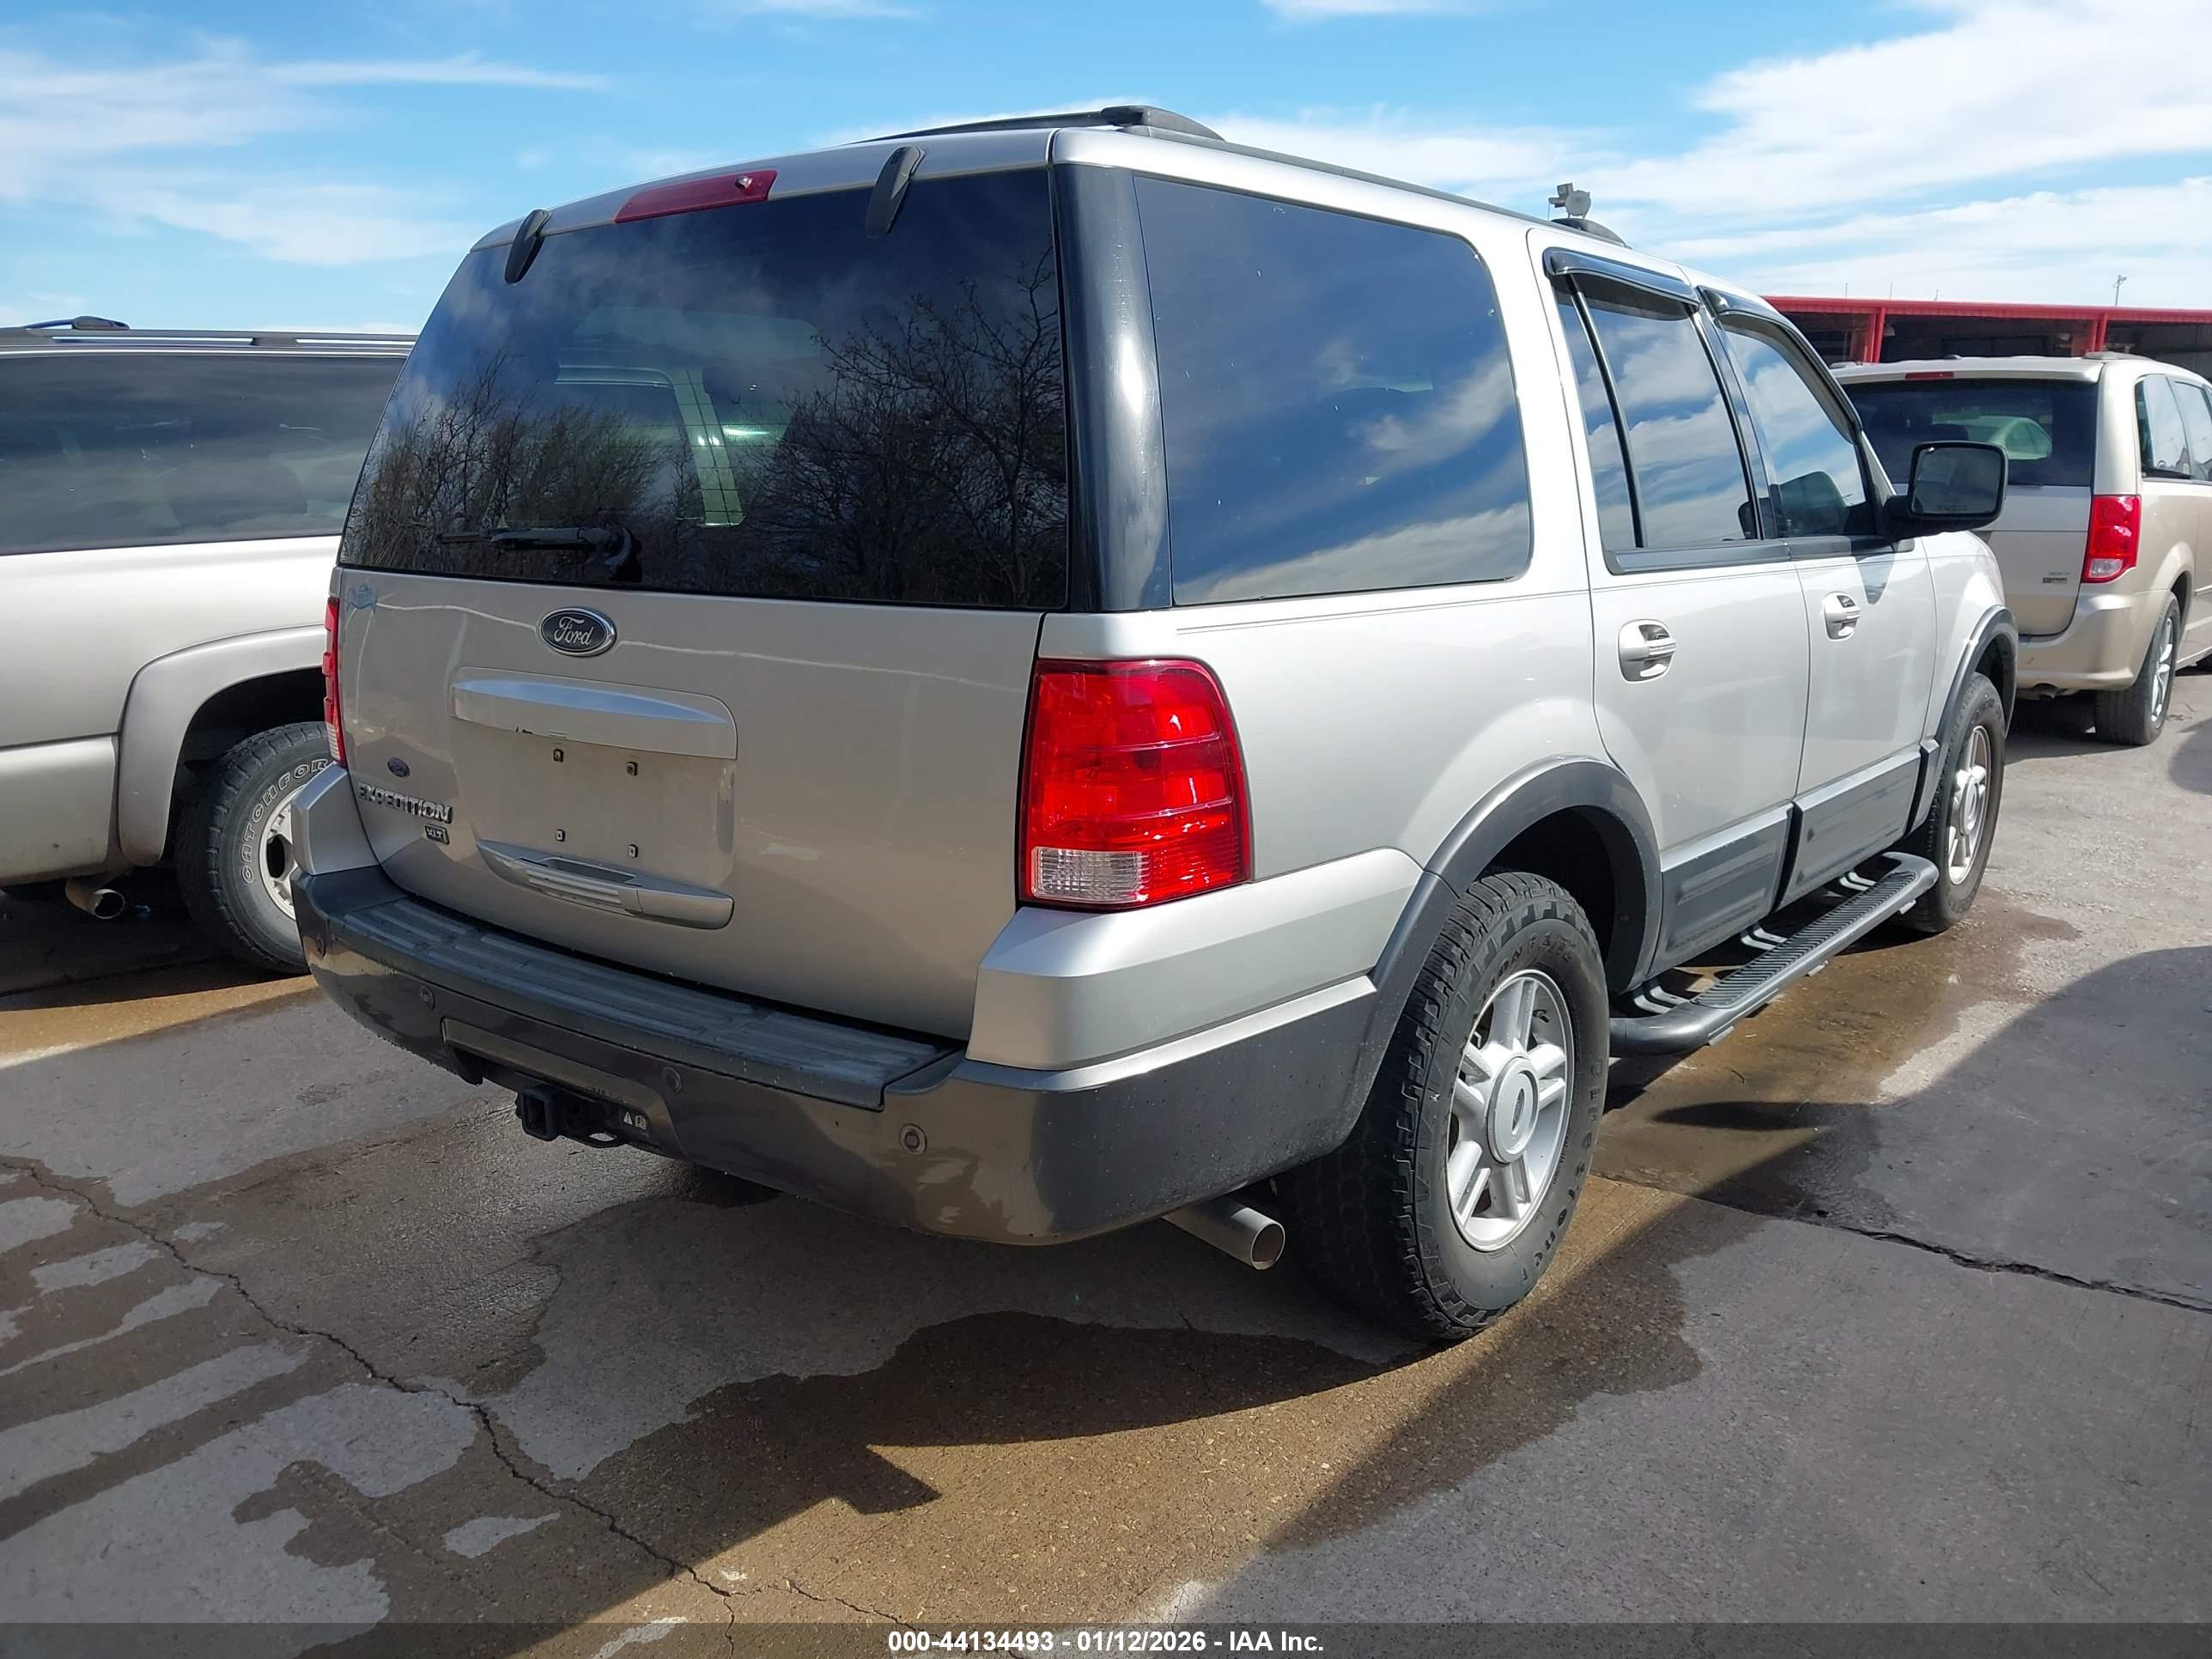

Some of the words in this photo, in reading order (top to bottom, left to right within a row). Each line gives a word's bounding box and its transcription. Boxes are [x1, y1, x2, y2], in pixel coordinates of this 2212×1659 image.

[554, 616, 594, 646] Ford
[358, 782, 453, 824] EXPEDITION
[426, 826, 447, 842] XLT
